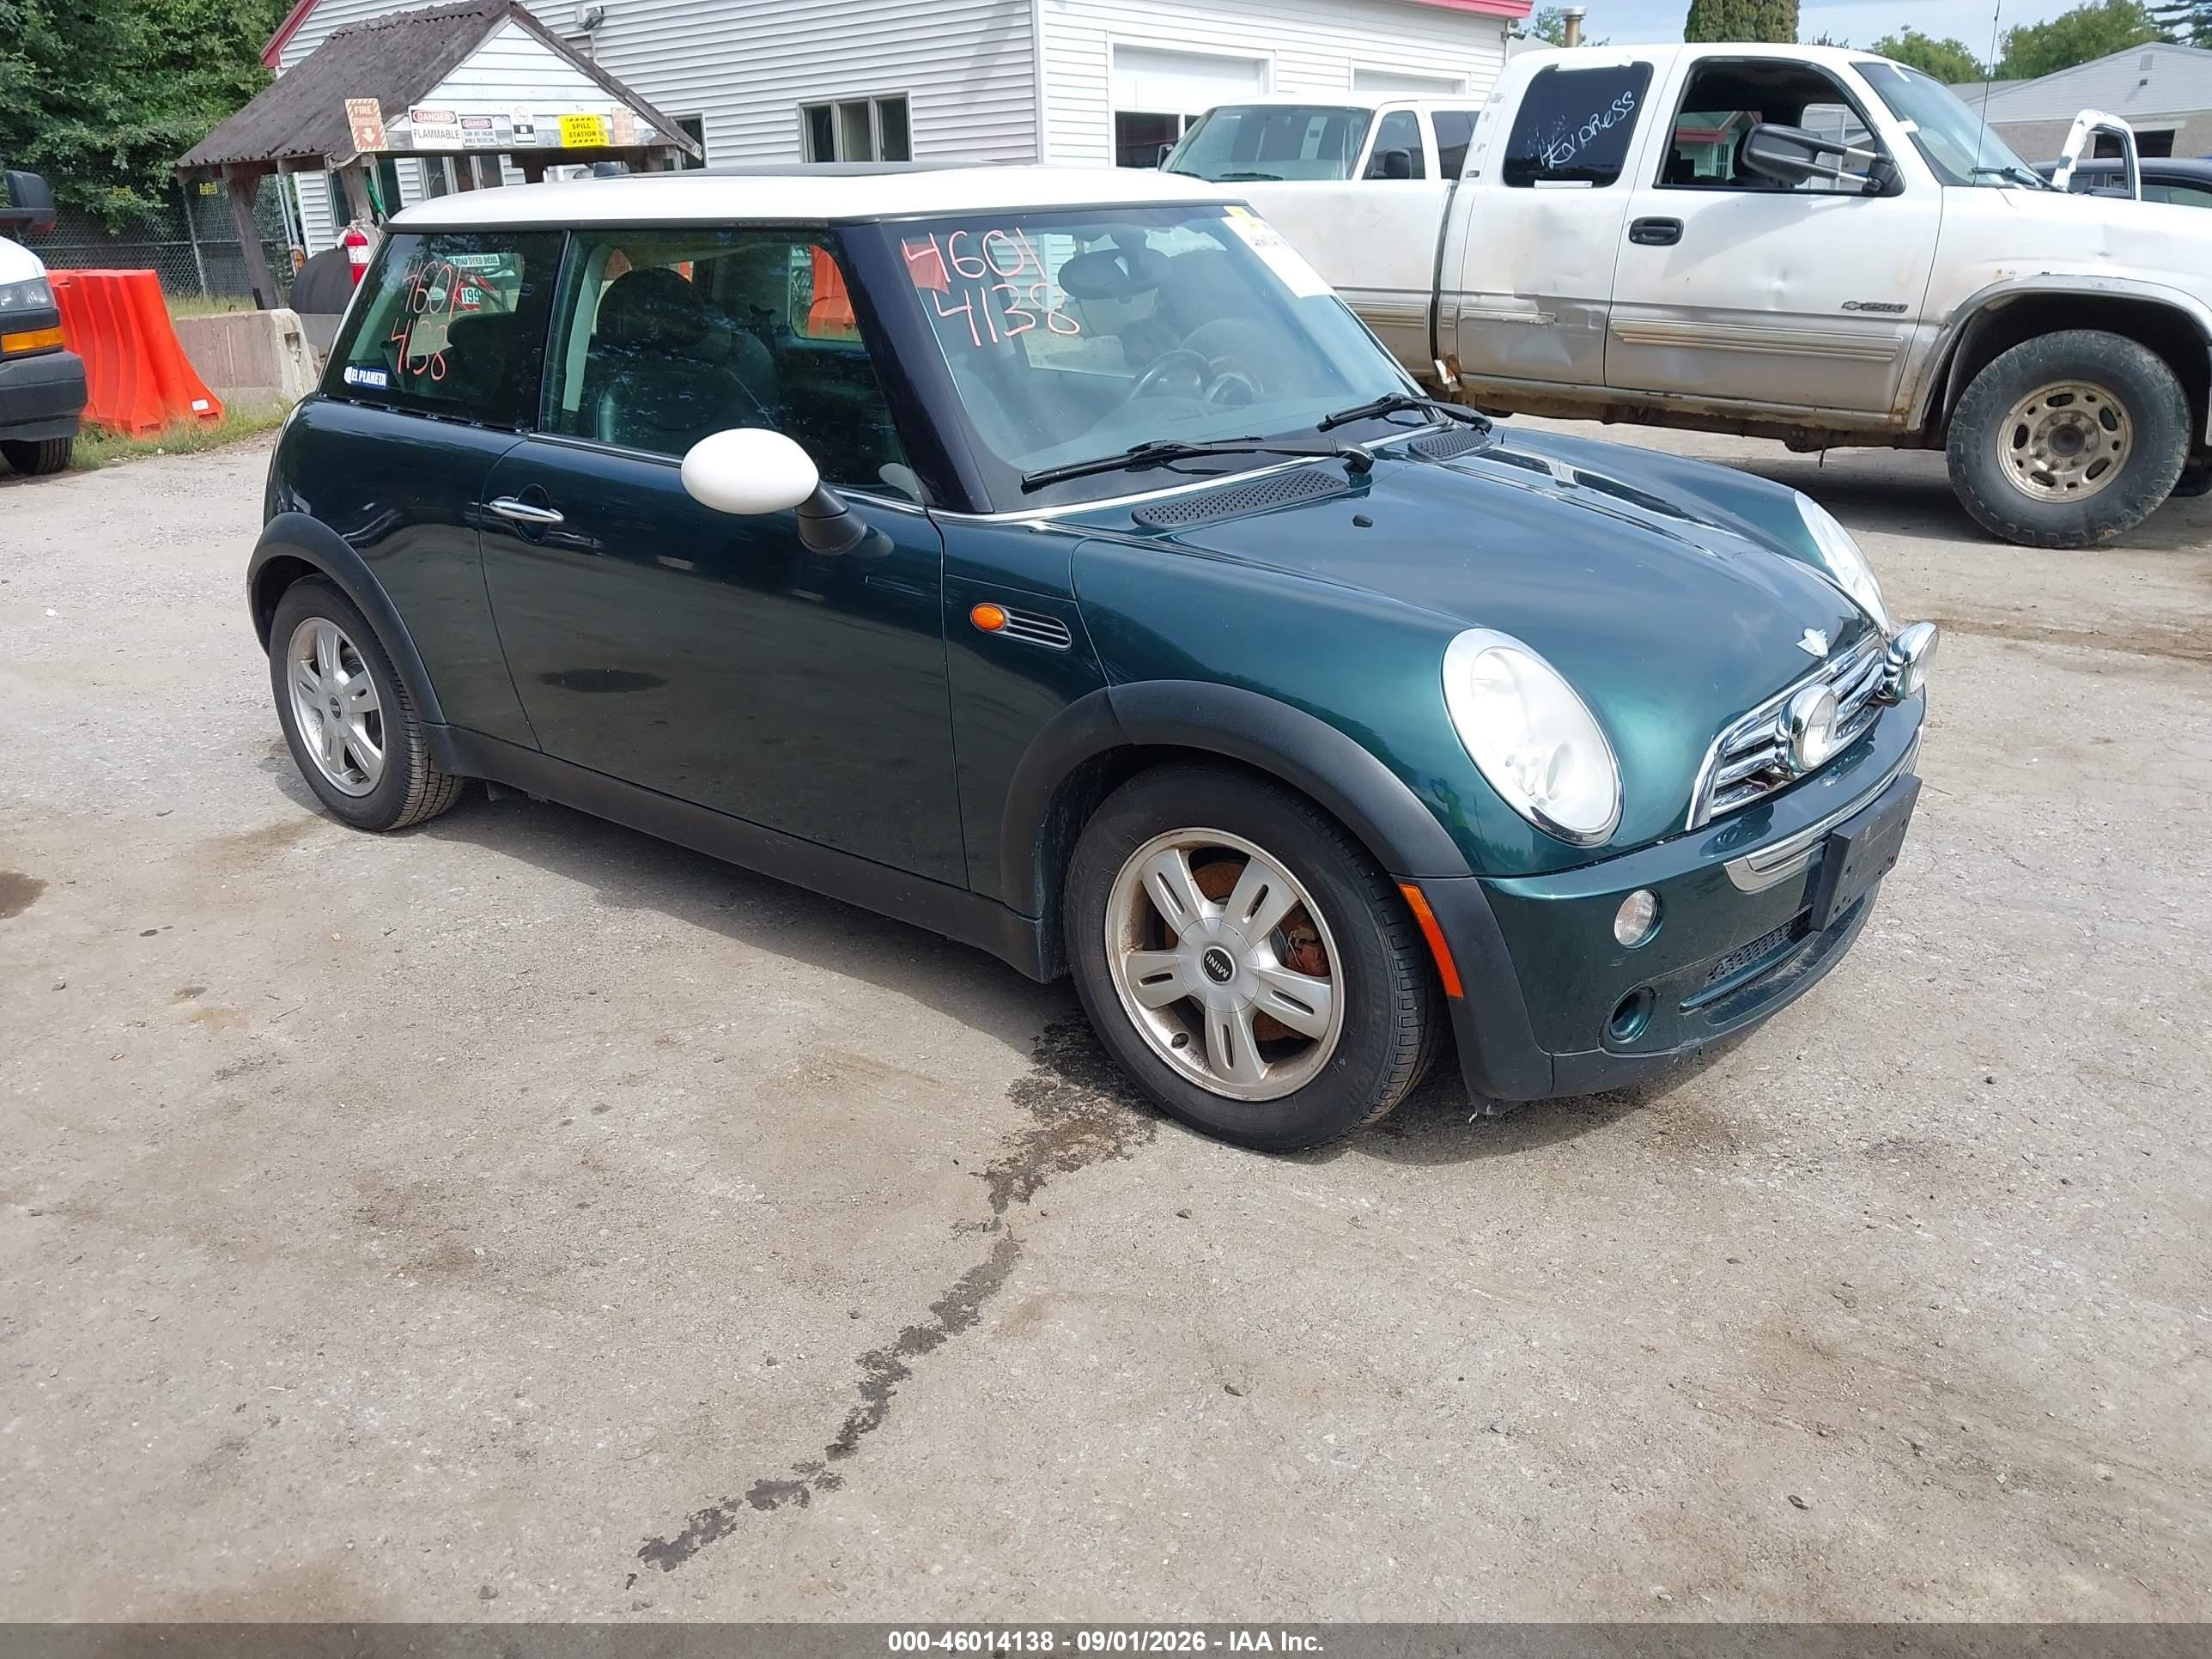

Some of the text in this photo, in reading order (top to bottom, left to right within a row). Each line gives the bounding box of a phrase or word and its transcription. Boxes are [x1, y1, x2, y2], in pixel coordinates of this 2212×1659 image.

[354, 105, 373, 114] FIRE
[417, 112, 451, 122] DANGER
[414, 129, 460, 139] FLAMMABLE
[901, 227, 1048, 283] 4601
[1860, 301, 1909, 313] 2500
[932, 282, 1081, 348] 4138
[1206, 951, 1230, 978] MINI
